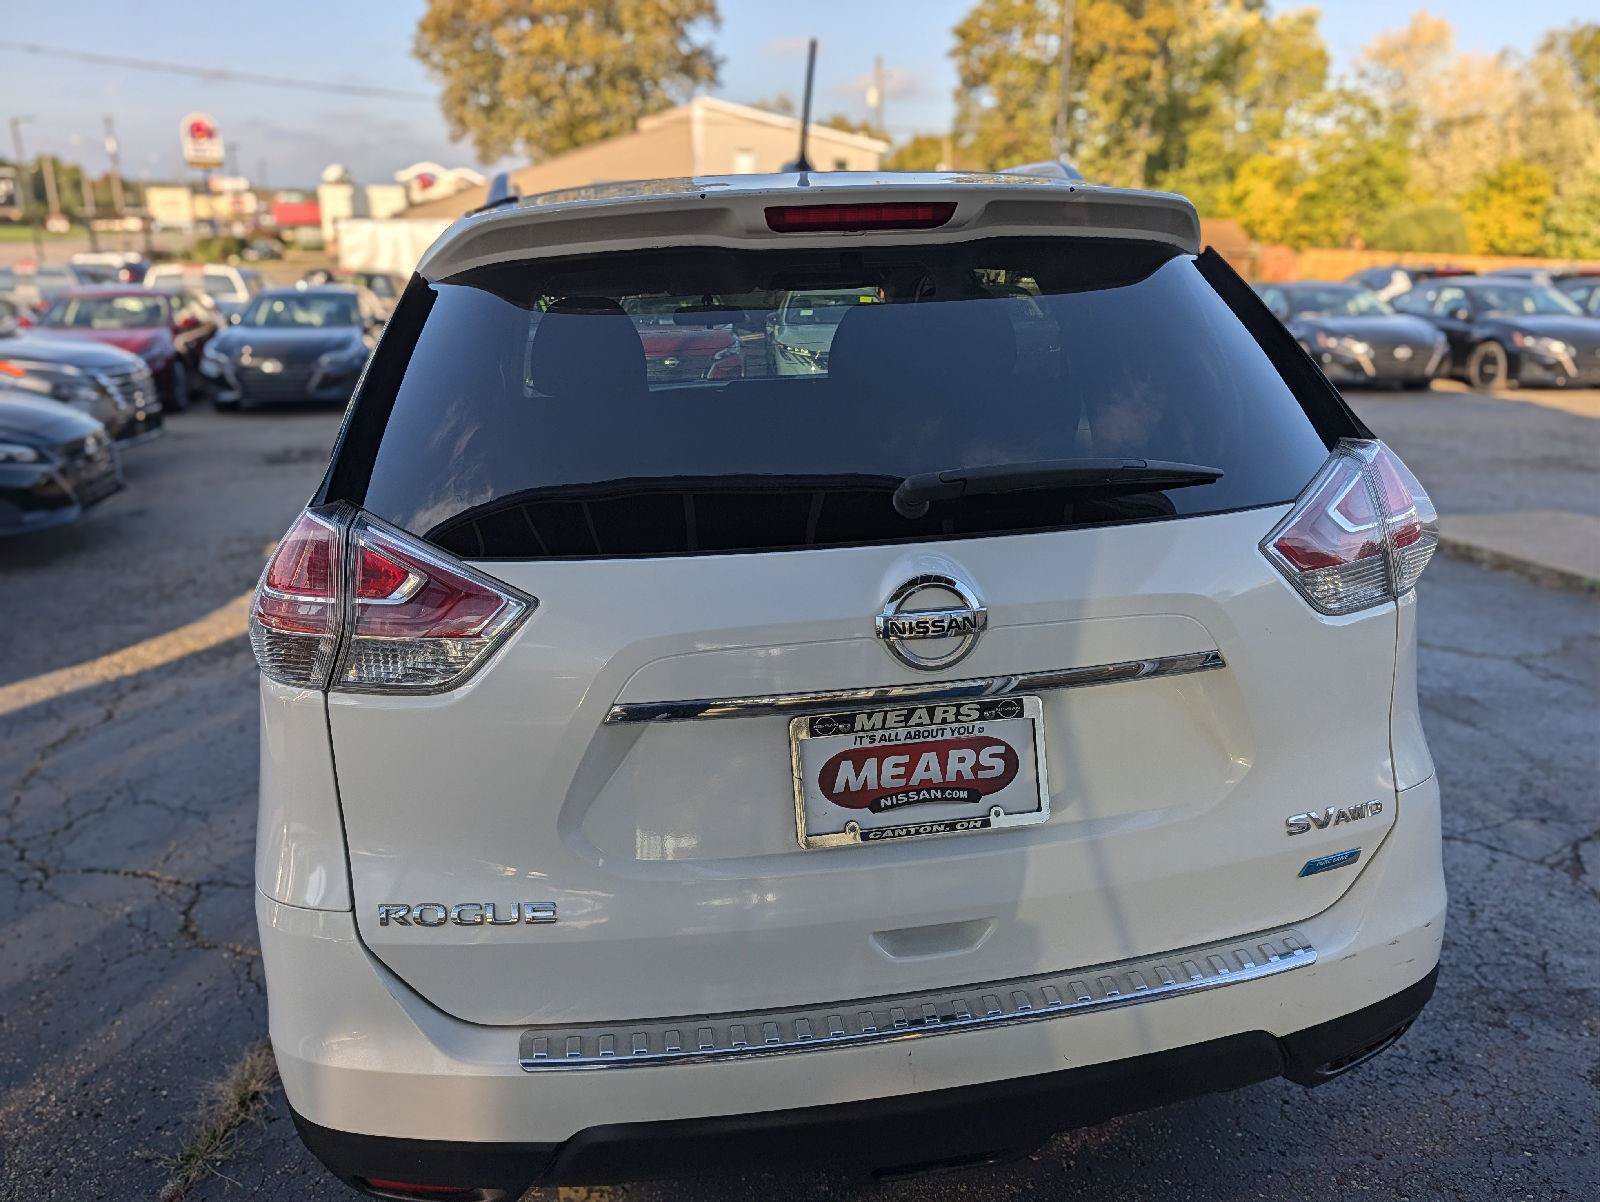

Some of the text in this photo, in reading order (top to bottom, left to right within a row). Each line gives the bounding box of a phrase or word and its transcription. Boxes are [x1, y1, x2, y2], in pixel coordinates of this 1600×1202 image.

[889, 616, 978, 635] NISSAN
[854, 703, 981, 731] MEARS
[854, 724, 976, 746] IT'S ALL ABOUT YOU
[832, 745, 1006, 794] MEARS
[880, 789, 968, 808] NISSAN.COM
[955, 820, 982, 830] OH
[1286, 799, 1383, 836] SV AWD
[378, 902, 557, 927] ROGUE
